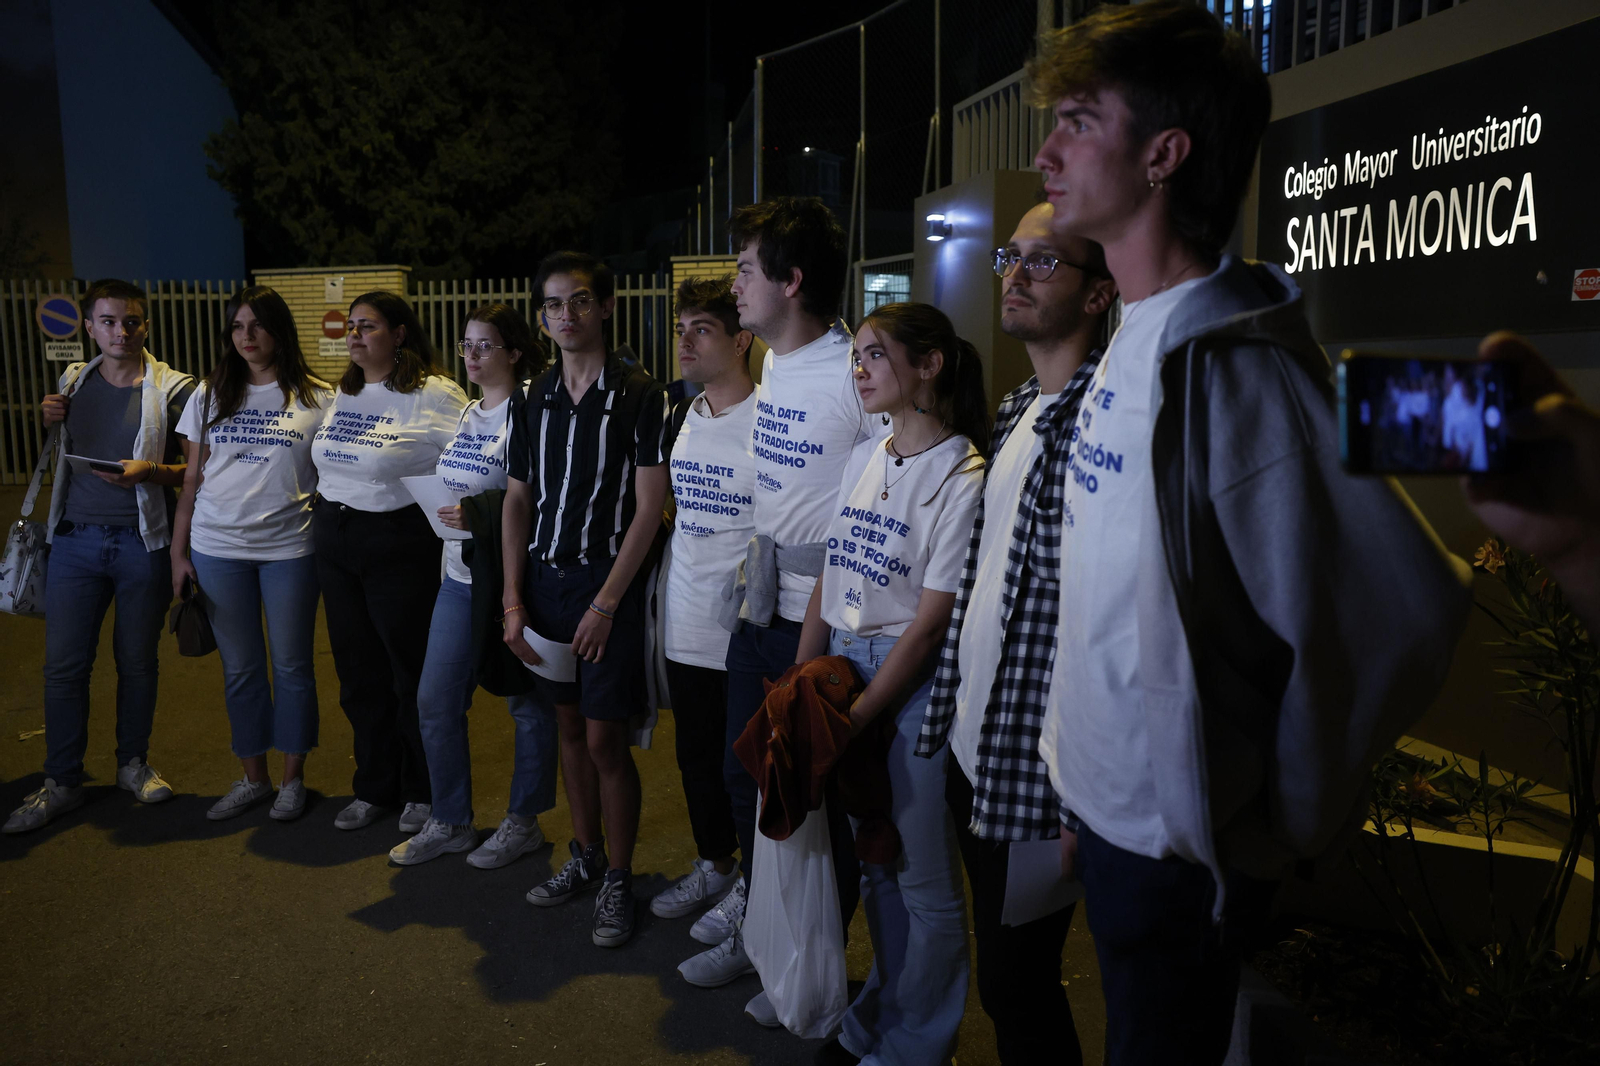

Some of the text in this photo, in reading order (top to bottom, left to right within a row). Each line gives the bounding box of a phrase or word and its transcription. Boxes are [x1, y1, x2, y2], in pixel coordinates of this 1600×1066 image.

[1284, 105, 1542, 200] Colegio Mayor Universitario
[1284, 172, 1538, 274] SANTA MONICA
[233, 417, 279, 426] CUENTA
[265, 410, 294, 419] DATE
[334, 411, 394, 425] AMIGA, DATE
[778, 407, 807, 422] DATE
[336, 420, 376, 430] CUENTA
[757, 416, 789, 435] CUENTA
[241, 426, 304, 440] TRADICIÓN
[338, 427, 399, 441] TRADICIÓN
[231, 436, 293, 447] MACHISMO
[324, 434, 384, 448] MACHISMO
[452, 441, 483, 450] CUENTA
[760, 432, 823, 455] TRADICIÓN
[451, 450, 504, 468] TRADICIÓN
[440, 459, 490, 476] MACHISMO
[671, 459, 734, 478] AMIGA, DATE
[676, 473, 721, 489] CUENTA
[685, 487, 752, 505] TRADICIÓN
[680, 498, 740, 517] MACHISMO
[883, 515, 911, 538] ATE
[842, 539, 857, 554] ES
[829, 554, 847, 567] ES
